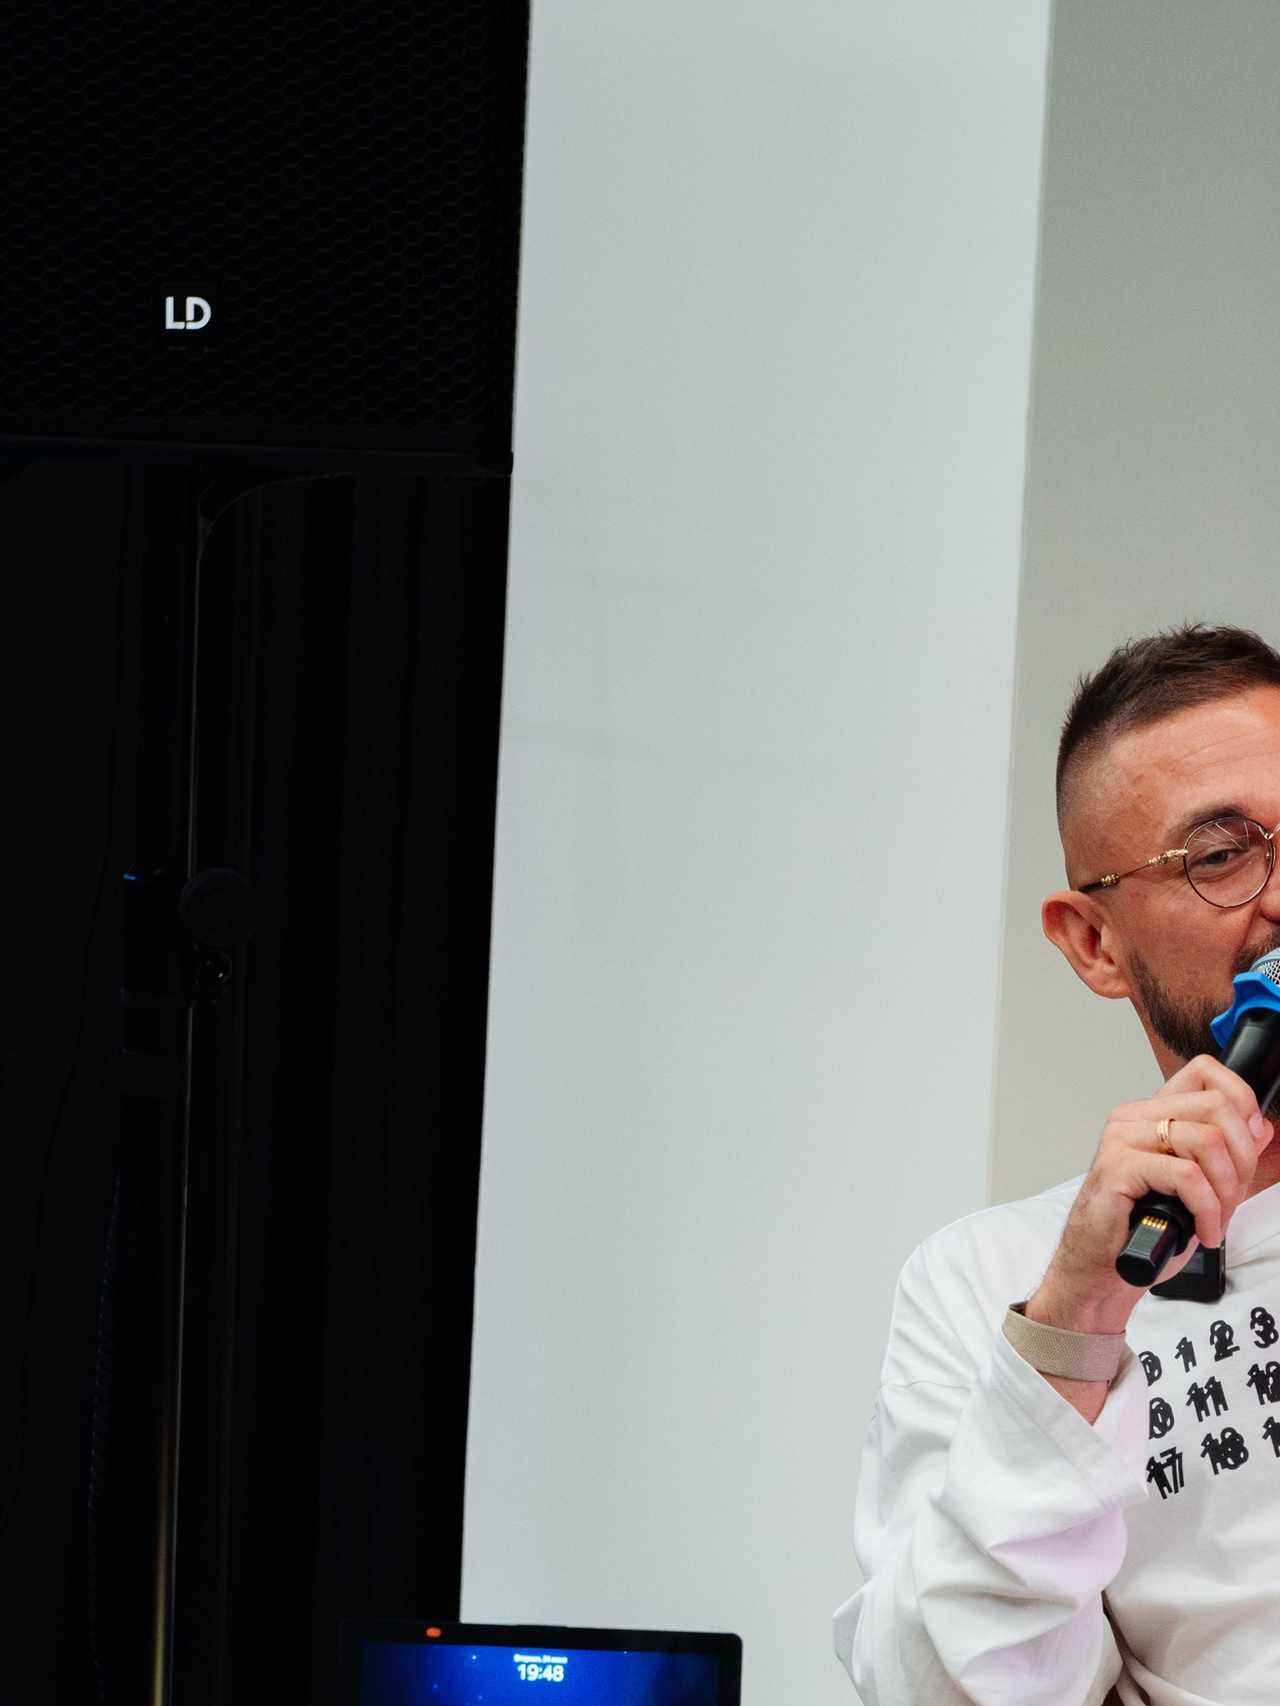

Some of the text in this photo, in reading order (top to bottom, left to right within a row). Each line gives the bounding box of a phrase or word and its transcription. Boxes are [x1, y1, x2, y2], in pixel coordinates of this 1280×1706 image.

[165, 296, 212, 330] LD
[1175, 1337, 1197, 1373] 1
[1210, 1320, 1240, 1362] 2
[1250, 1307, 1279, 1348] 3
[1186, 1376, 1228, 1422] 11
[1146, 1447, 1184, 1500] 17
[1201, 1427, 1249, 1475] 18
[516, 1663, 565, 1682] 19:48
